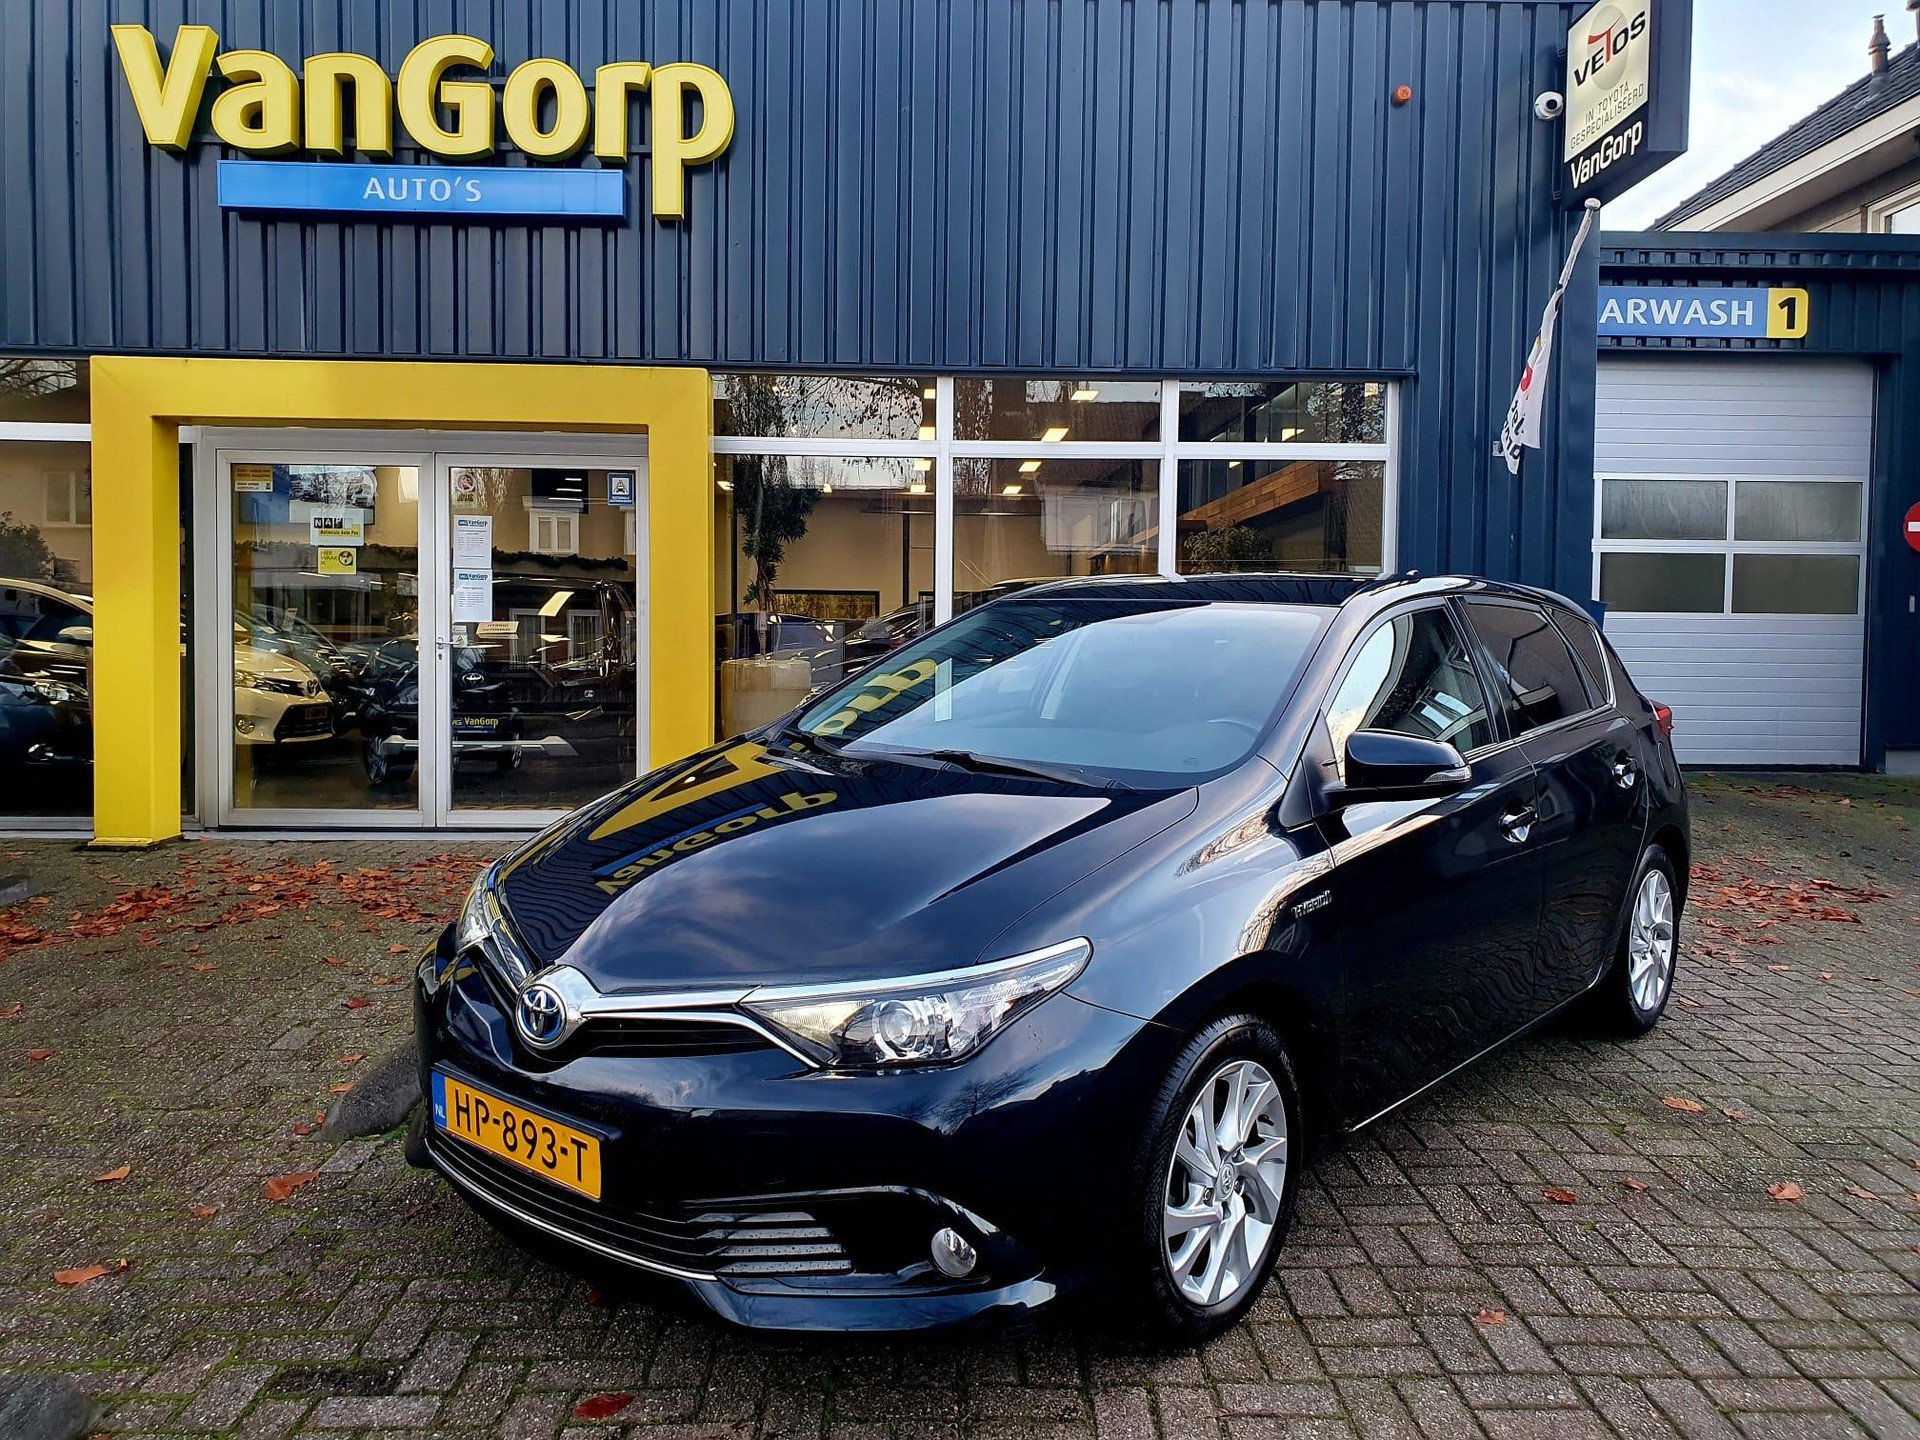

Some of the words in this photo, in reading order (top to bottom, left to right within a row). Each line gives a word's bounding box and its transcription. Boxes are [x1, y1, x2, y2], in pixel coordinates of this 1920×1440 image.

[1573, 11, 1646, 87] VETOS
[110, 24, 735, 221] VanGorp
[1570, 83, 1645, 150] GESPECIALISEERD
[1585, 110, 1594, 125] IN
[1598, 81, 1630, 115] TOYOTA
[1571, 120, 1643, 189] VanGorp
[362, 175, 483, 203] AUTO'S
[1599, 298, 1754, 326] ARWASH
[1777, 297, 1797, 330] 1
[464, 716, 499, 729] VanGorp
[434, 1101, 447, 1121] NL
[454, 1087, 588, 1183] HP-893-T
